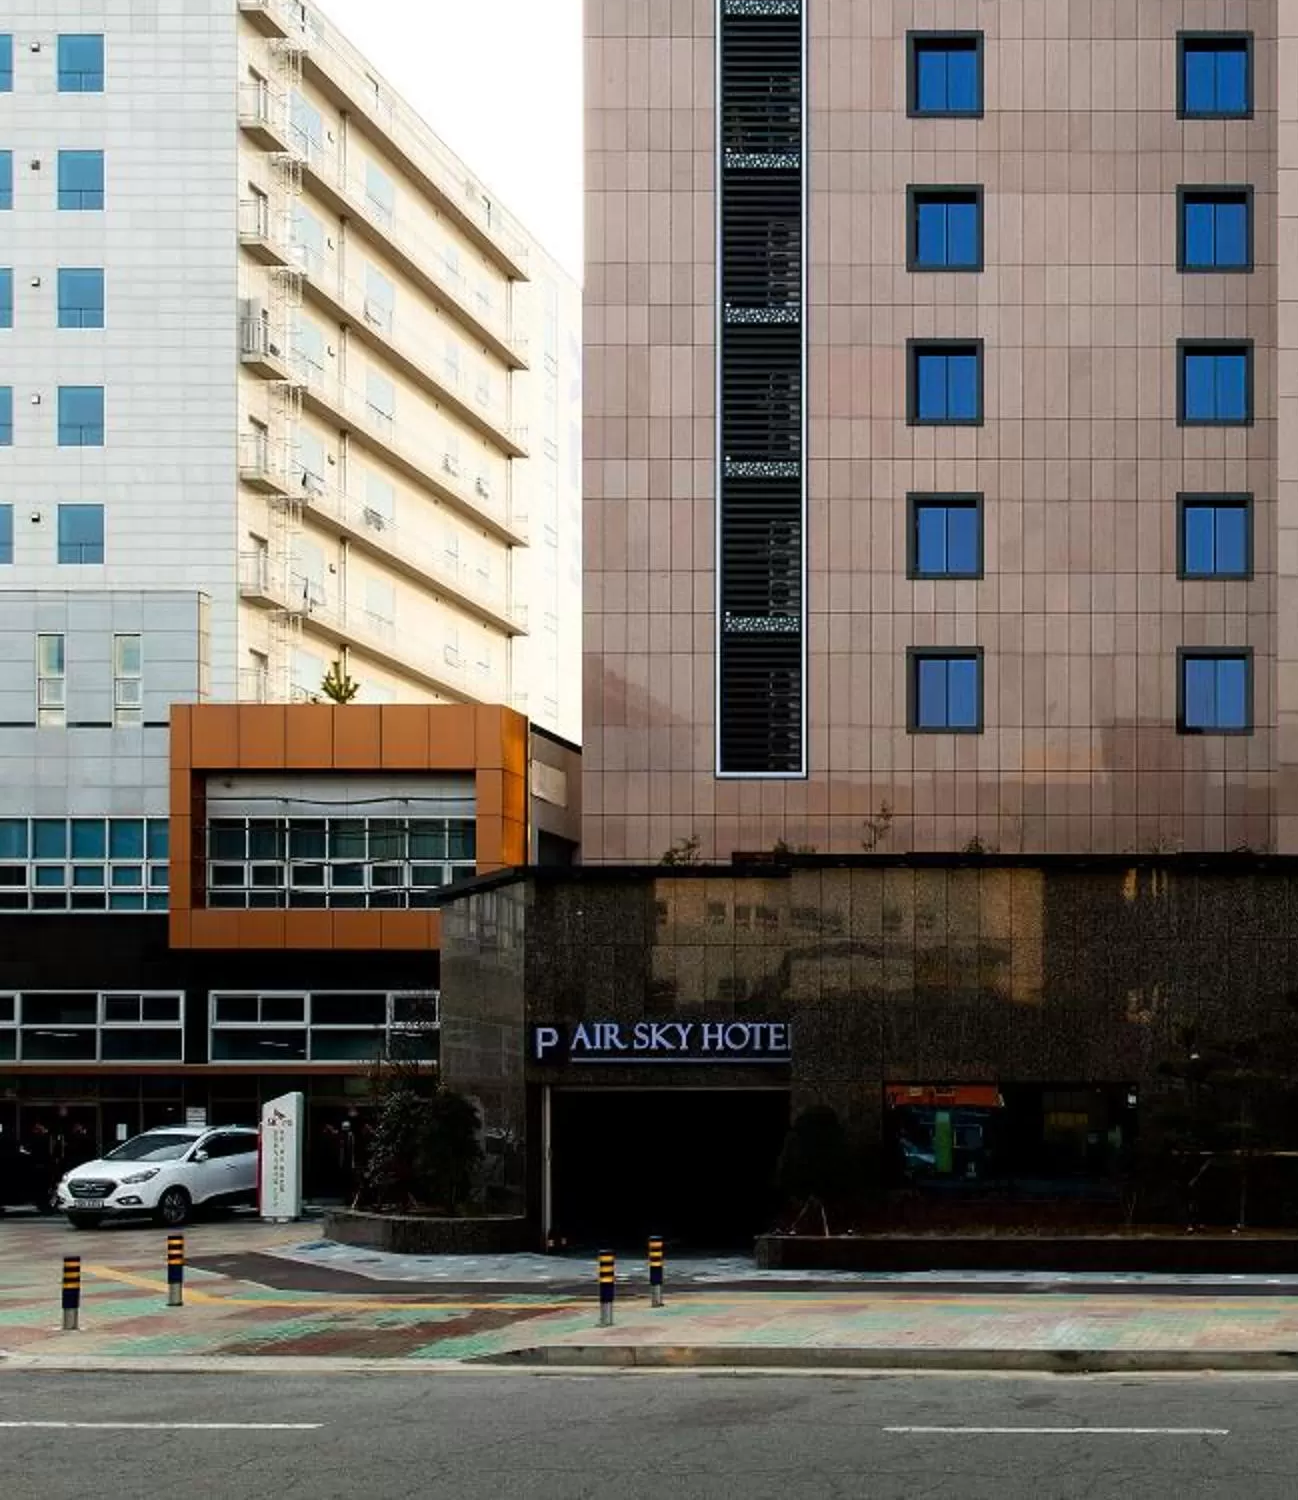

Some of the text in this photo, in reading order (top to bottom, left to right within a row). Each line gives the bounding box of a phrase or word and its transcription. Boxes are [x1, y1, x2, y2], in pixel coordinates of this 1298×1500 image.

[536, 1027, 559, 1059] P
[570, 1023, 792, 1050] AIR SKY HOTE
